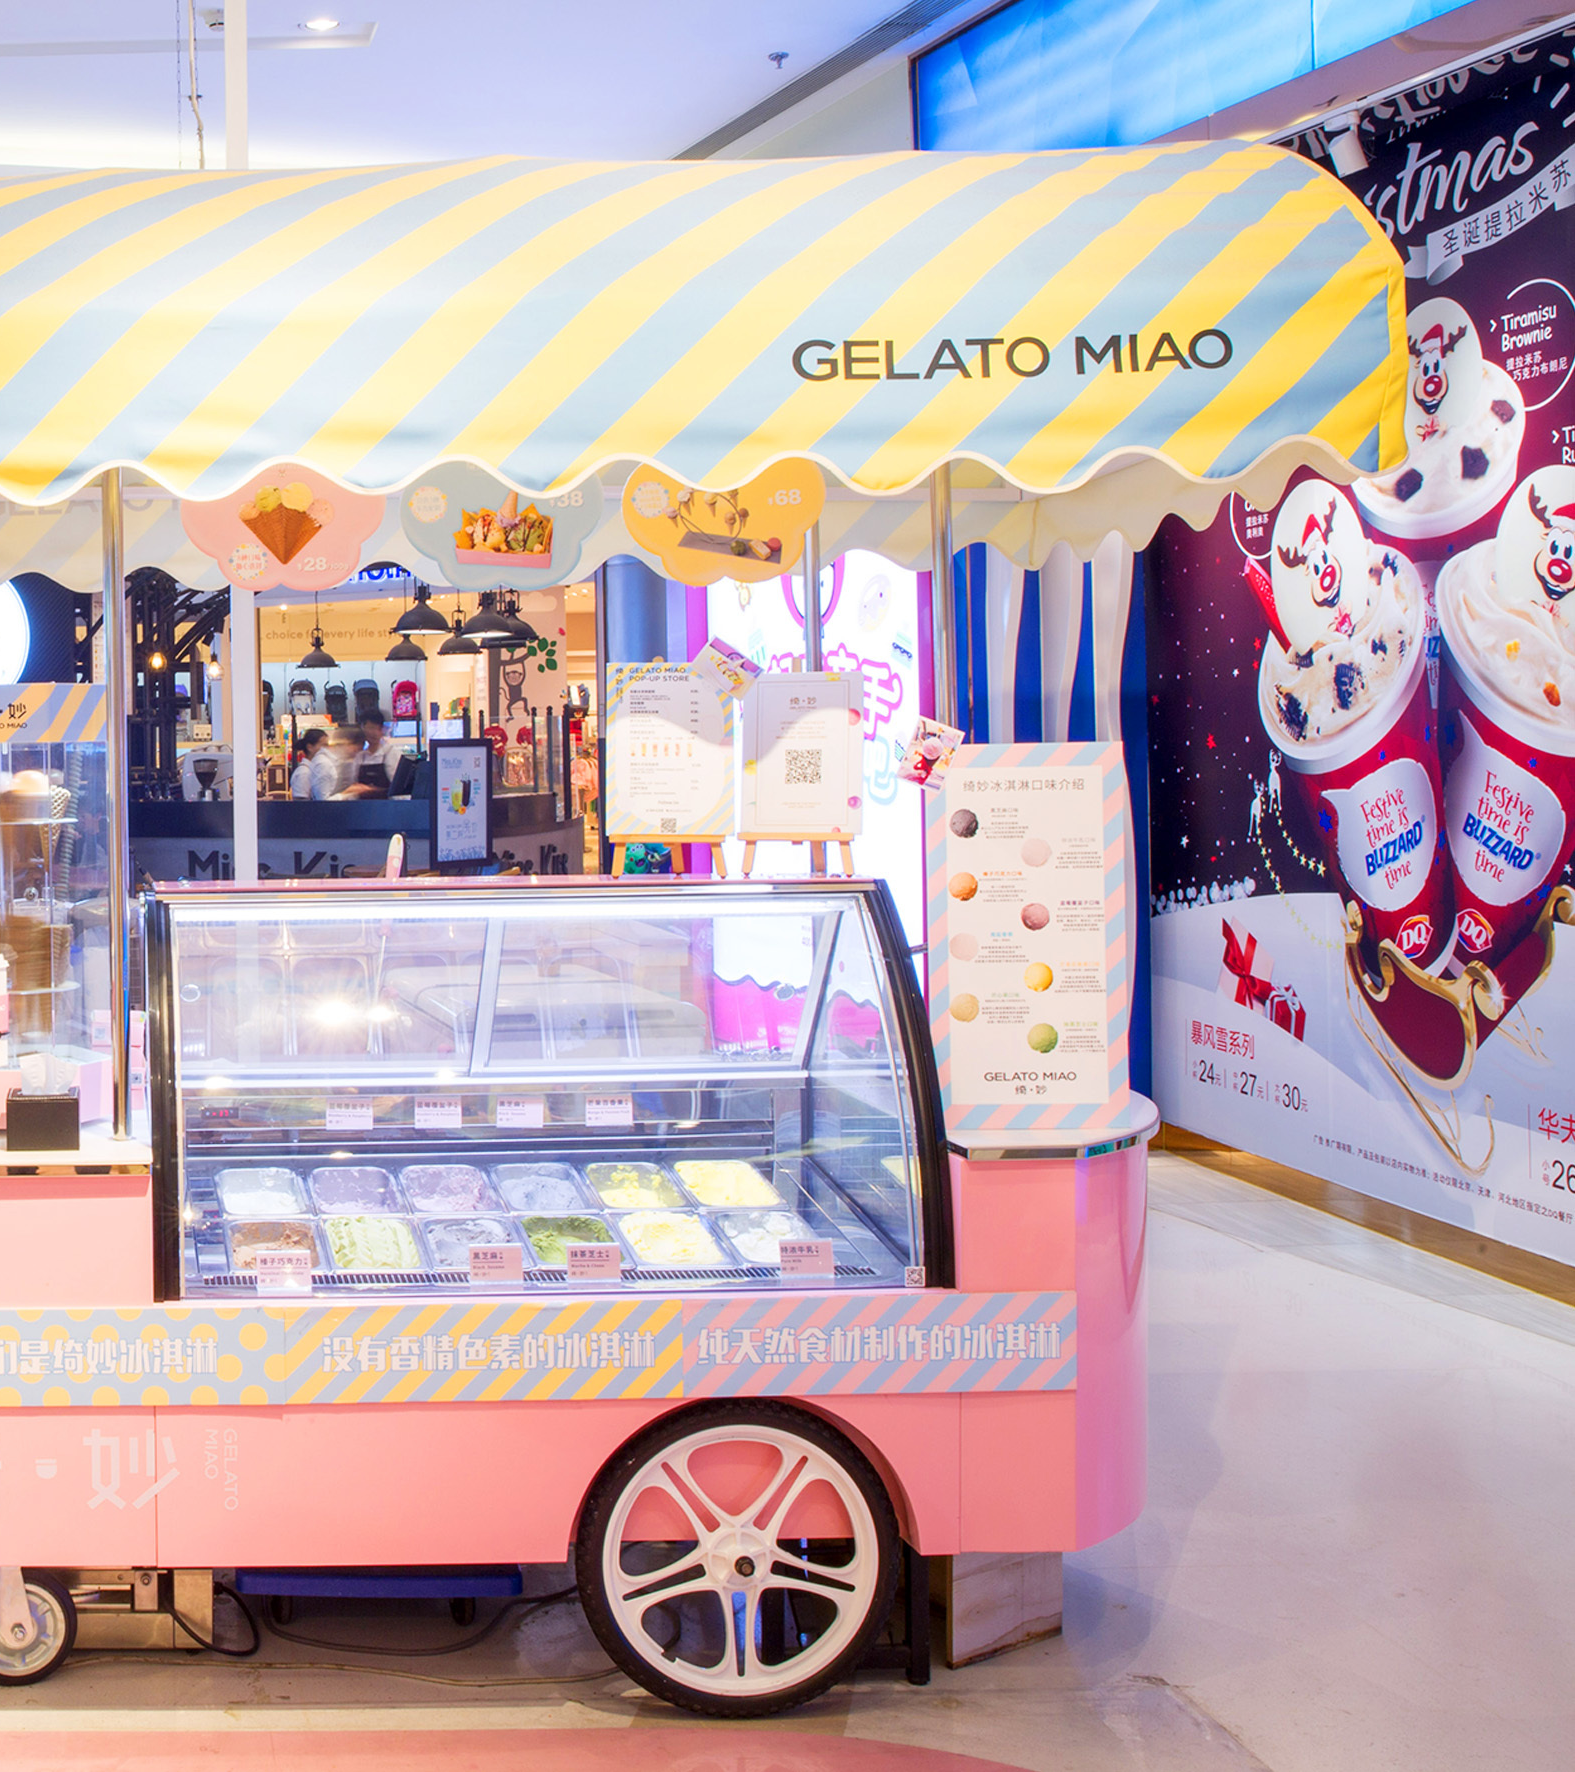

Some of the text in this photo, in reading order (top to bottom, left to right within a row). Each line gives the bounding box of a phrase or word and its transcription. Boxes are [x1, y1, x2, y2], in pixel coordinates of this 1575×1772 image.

[1442, 158, 1572, 258] 圣诞提拉米苏
[1500, 304, 1557, 332] Tiramisu
[791, 328, 1234, 382] GELATO MIAO
[1501, 325, 1553, 352] Brownie
[1505, 350, 1543, 371] 提拉米苏
[1512, 356, 1569, 382] 巧克力布朗尼
[265, 630, 304, 640] choice
[324, 630, 355, 643] every
[357, 627, 375, 638] life
[7, 721, 28, 730] MIAO
[962, 778, 1085, 793] 绮妙冰淇淋口味介绍
[1485, 770, 1535, 824] Festive
[1360, 788, 1406, 824] Festive
[1478, 796, 1530, 846] time is
[1365, 806, 1409, 849] time is
[1462, 812, 1535, 871] BLIZZARD
[1364, 820, 1423, 877] BLIZZARD
[1475, 849, 1506, 883] time
[1384, 860, 1412, 890] time
[1401, 923, 1428, 950] DQ
[1459, 916, 1487, 945] DQ
[1191, 1020, 1255, 1060] 暴风雪系列
[984, 1071, 1077, 1082] GELATO MIAO
[322, 1330, 656, 1374] 没有香精色素的冰淇淋
[697, 1321, 1062, 1367] 纯天然食材制作的冰淇淋
[204, 1428, 218, 1480] MIAO
[223, 1428, 239, 1511] GELATO
